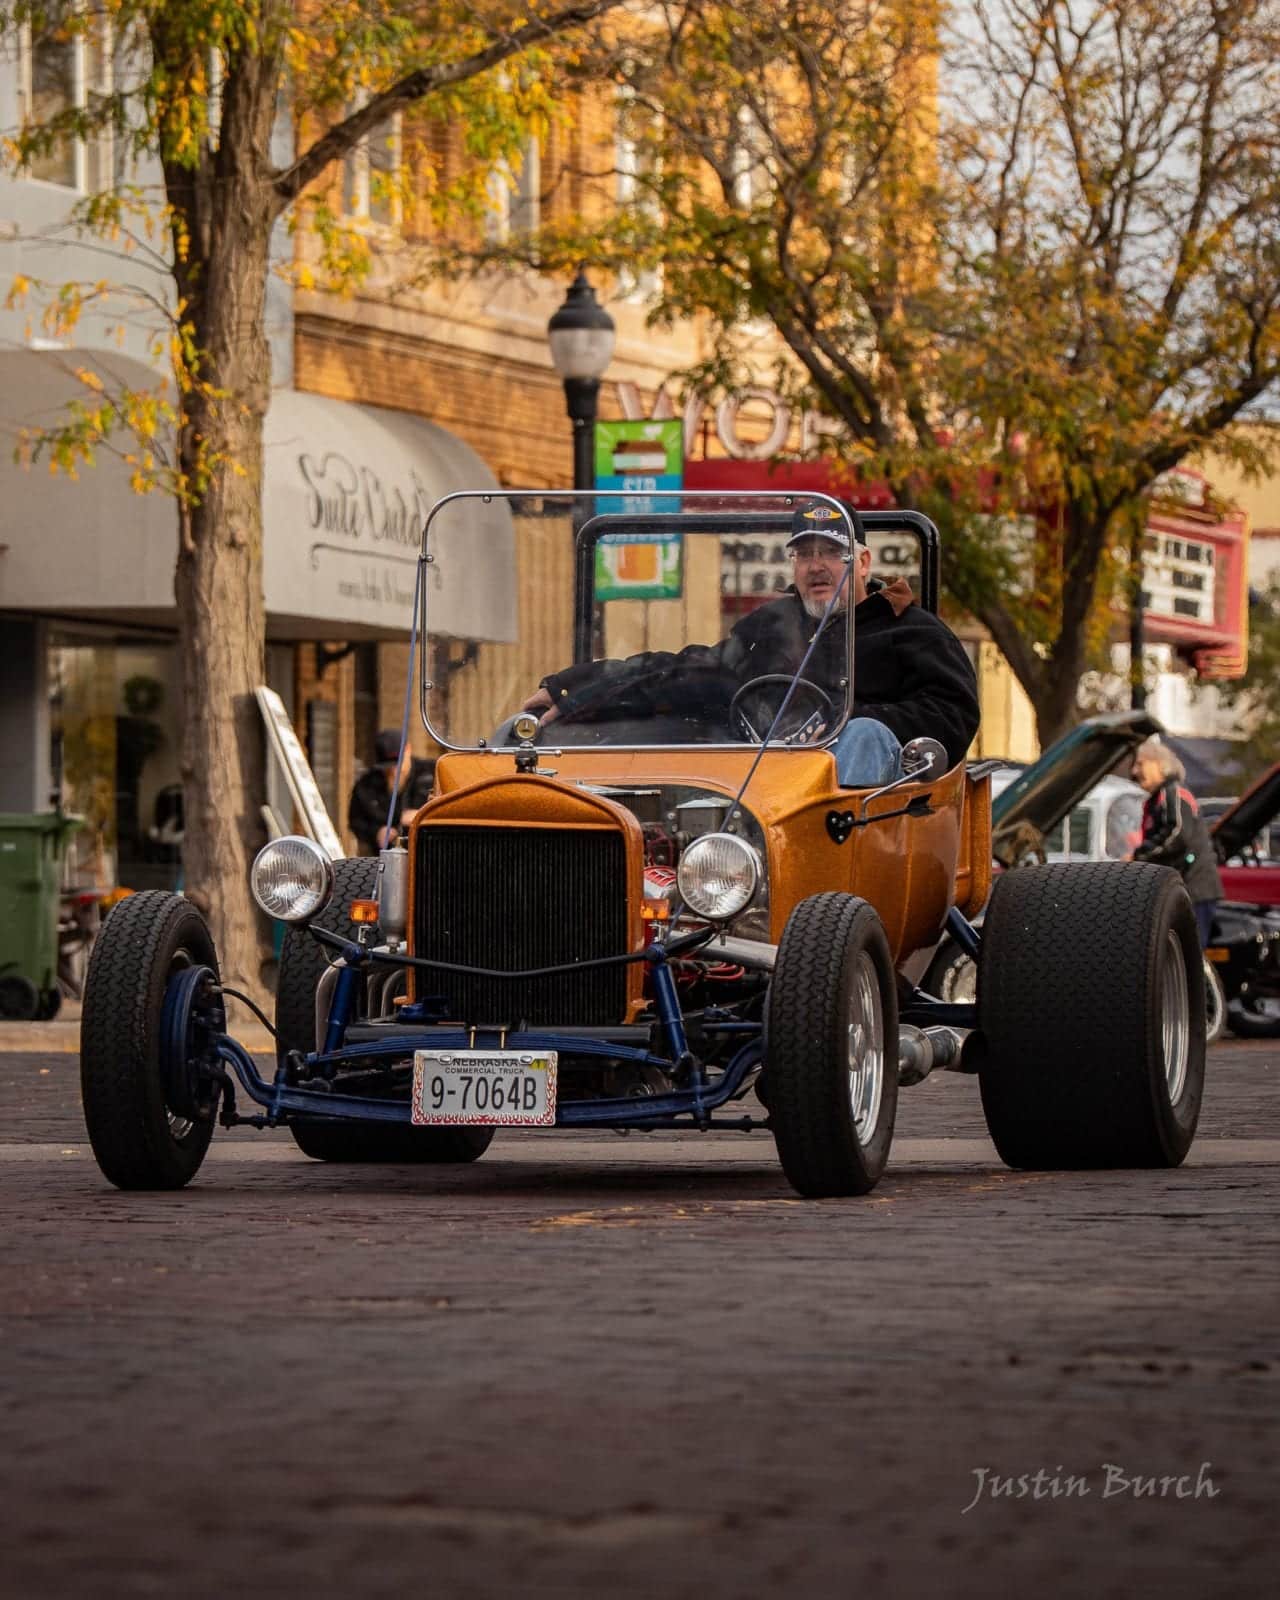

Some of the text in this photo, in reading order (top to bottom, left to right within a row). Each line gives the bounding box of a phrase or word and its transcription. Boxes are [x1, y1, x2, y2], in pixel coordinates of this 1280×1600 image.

[452, 1058, 519, 1067] NEBRASKA
[445, 1066, 525, 1075] COMMERCIAL TRUCK
[430, 1075, 537, 1111] 9-7064B
